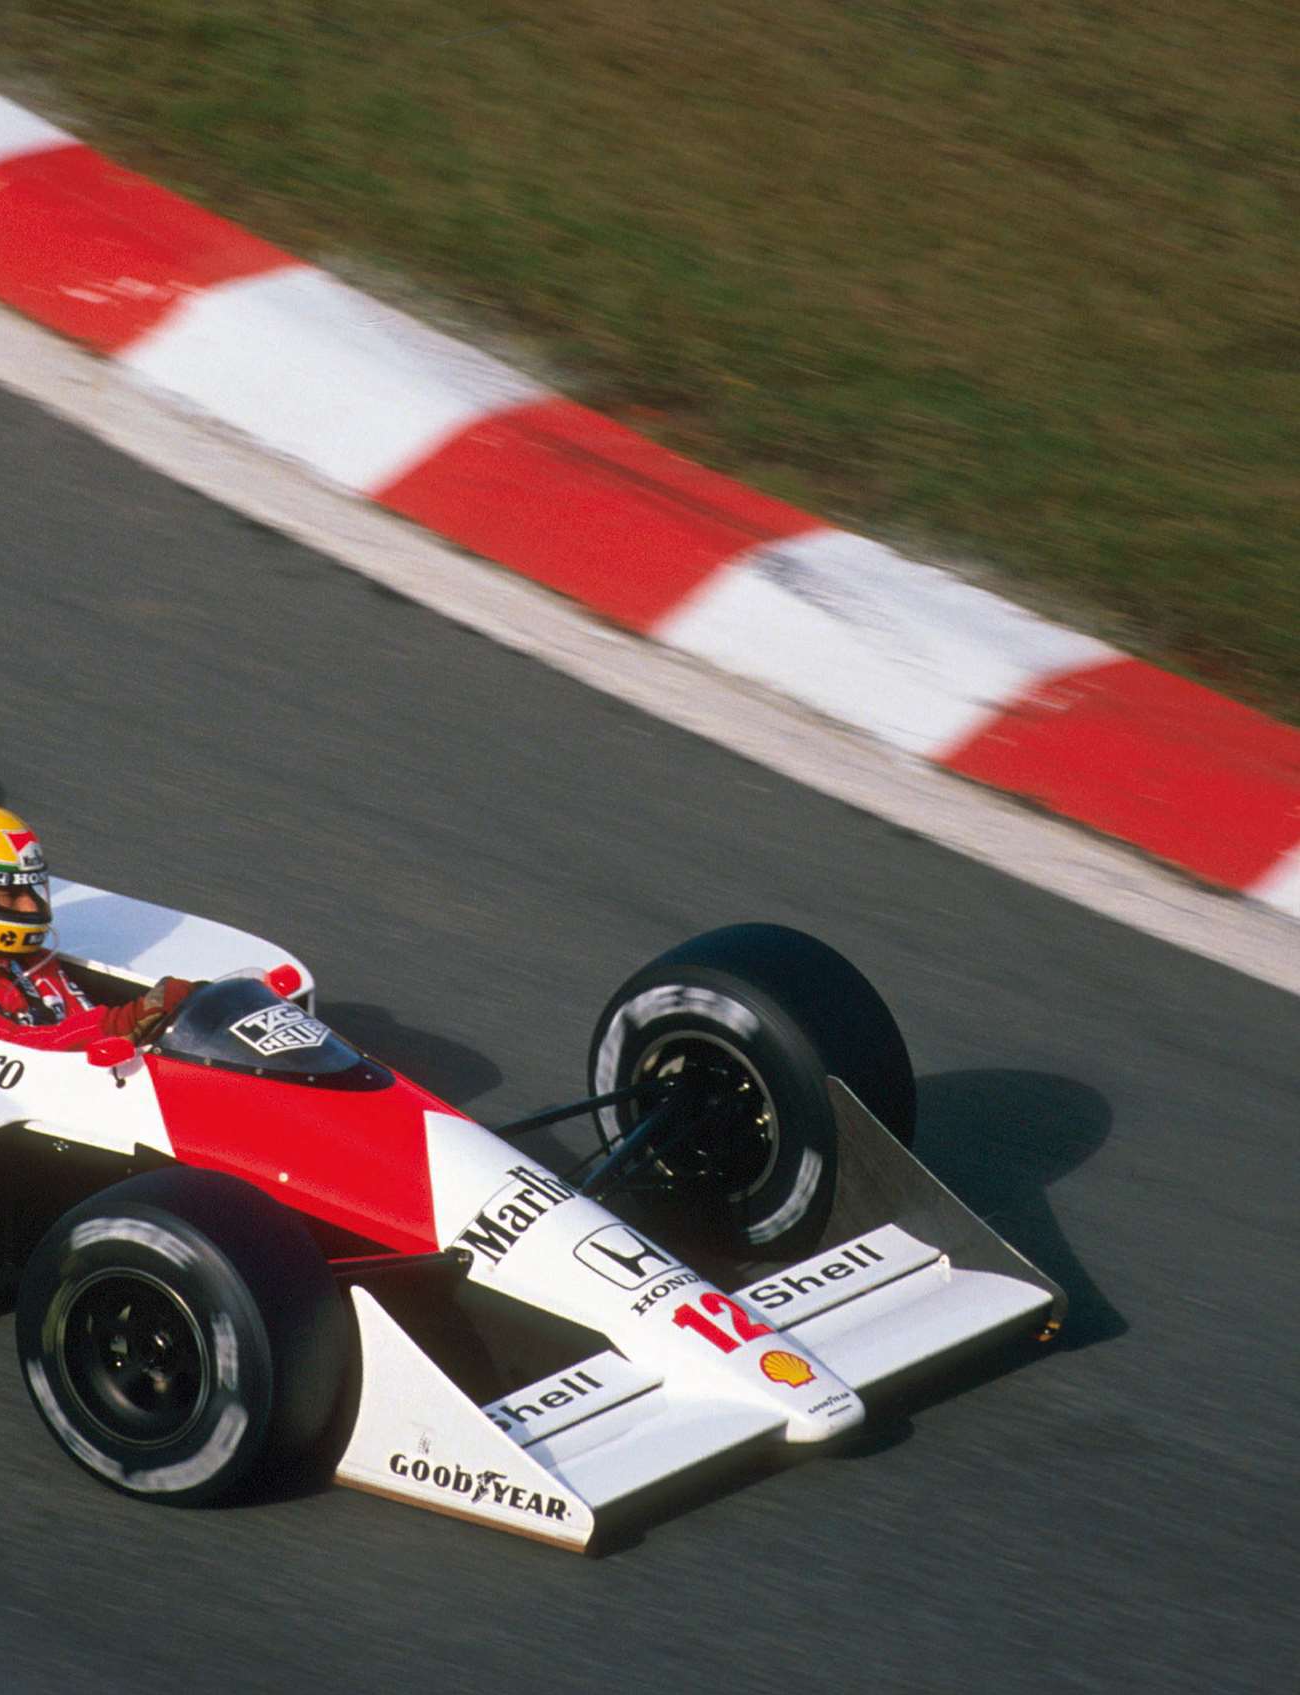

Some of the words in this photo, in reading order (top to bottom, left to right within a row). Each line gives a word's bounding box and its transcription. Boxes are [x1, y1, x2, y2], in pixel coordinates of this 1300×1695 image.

[244, 1007, 304, 1033] TAG
[261, 1019, 326, 1050] HEUE
[630, 1273, 699, 1316] HOND
[749, 1244, 884, 1309] Shell
[671, 1292, 775, 1354] 12
